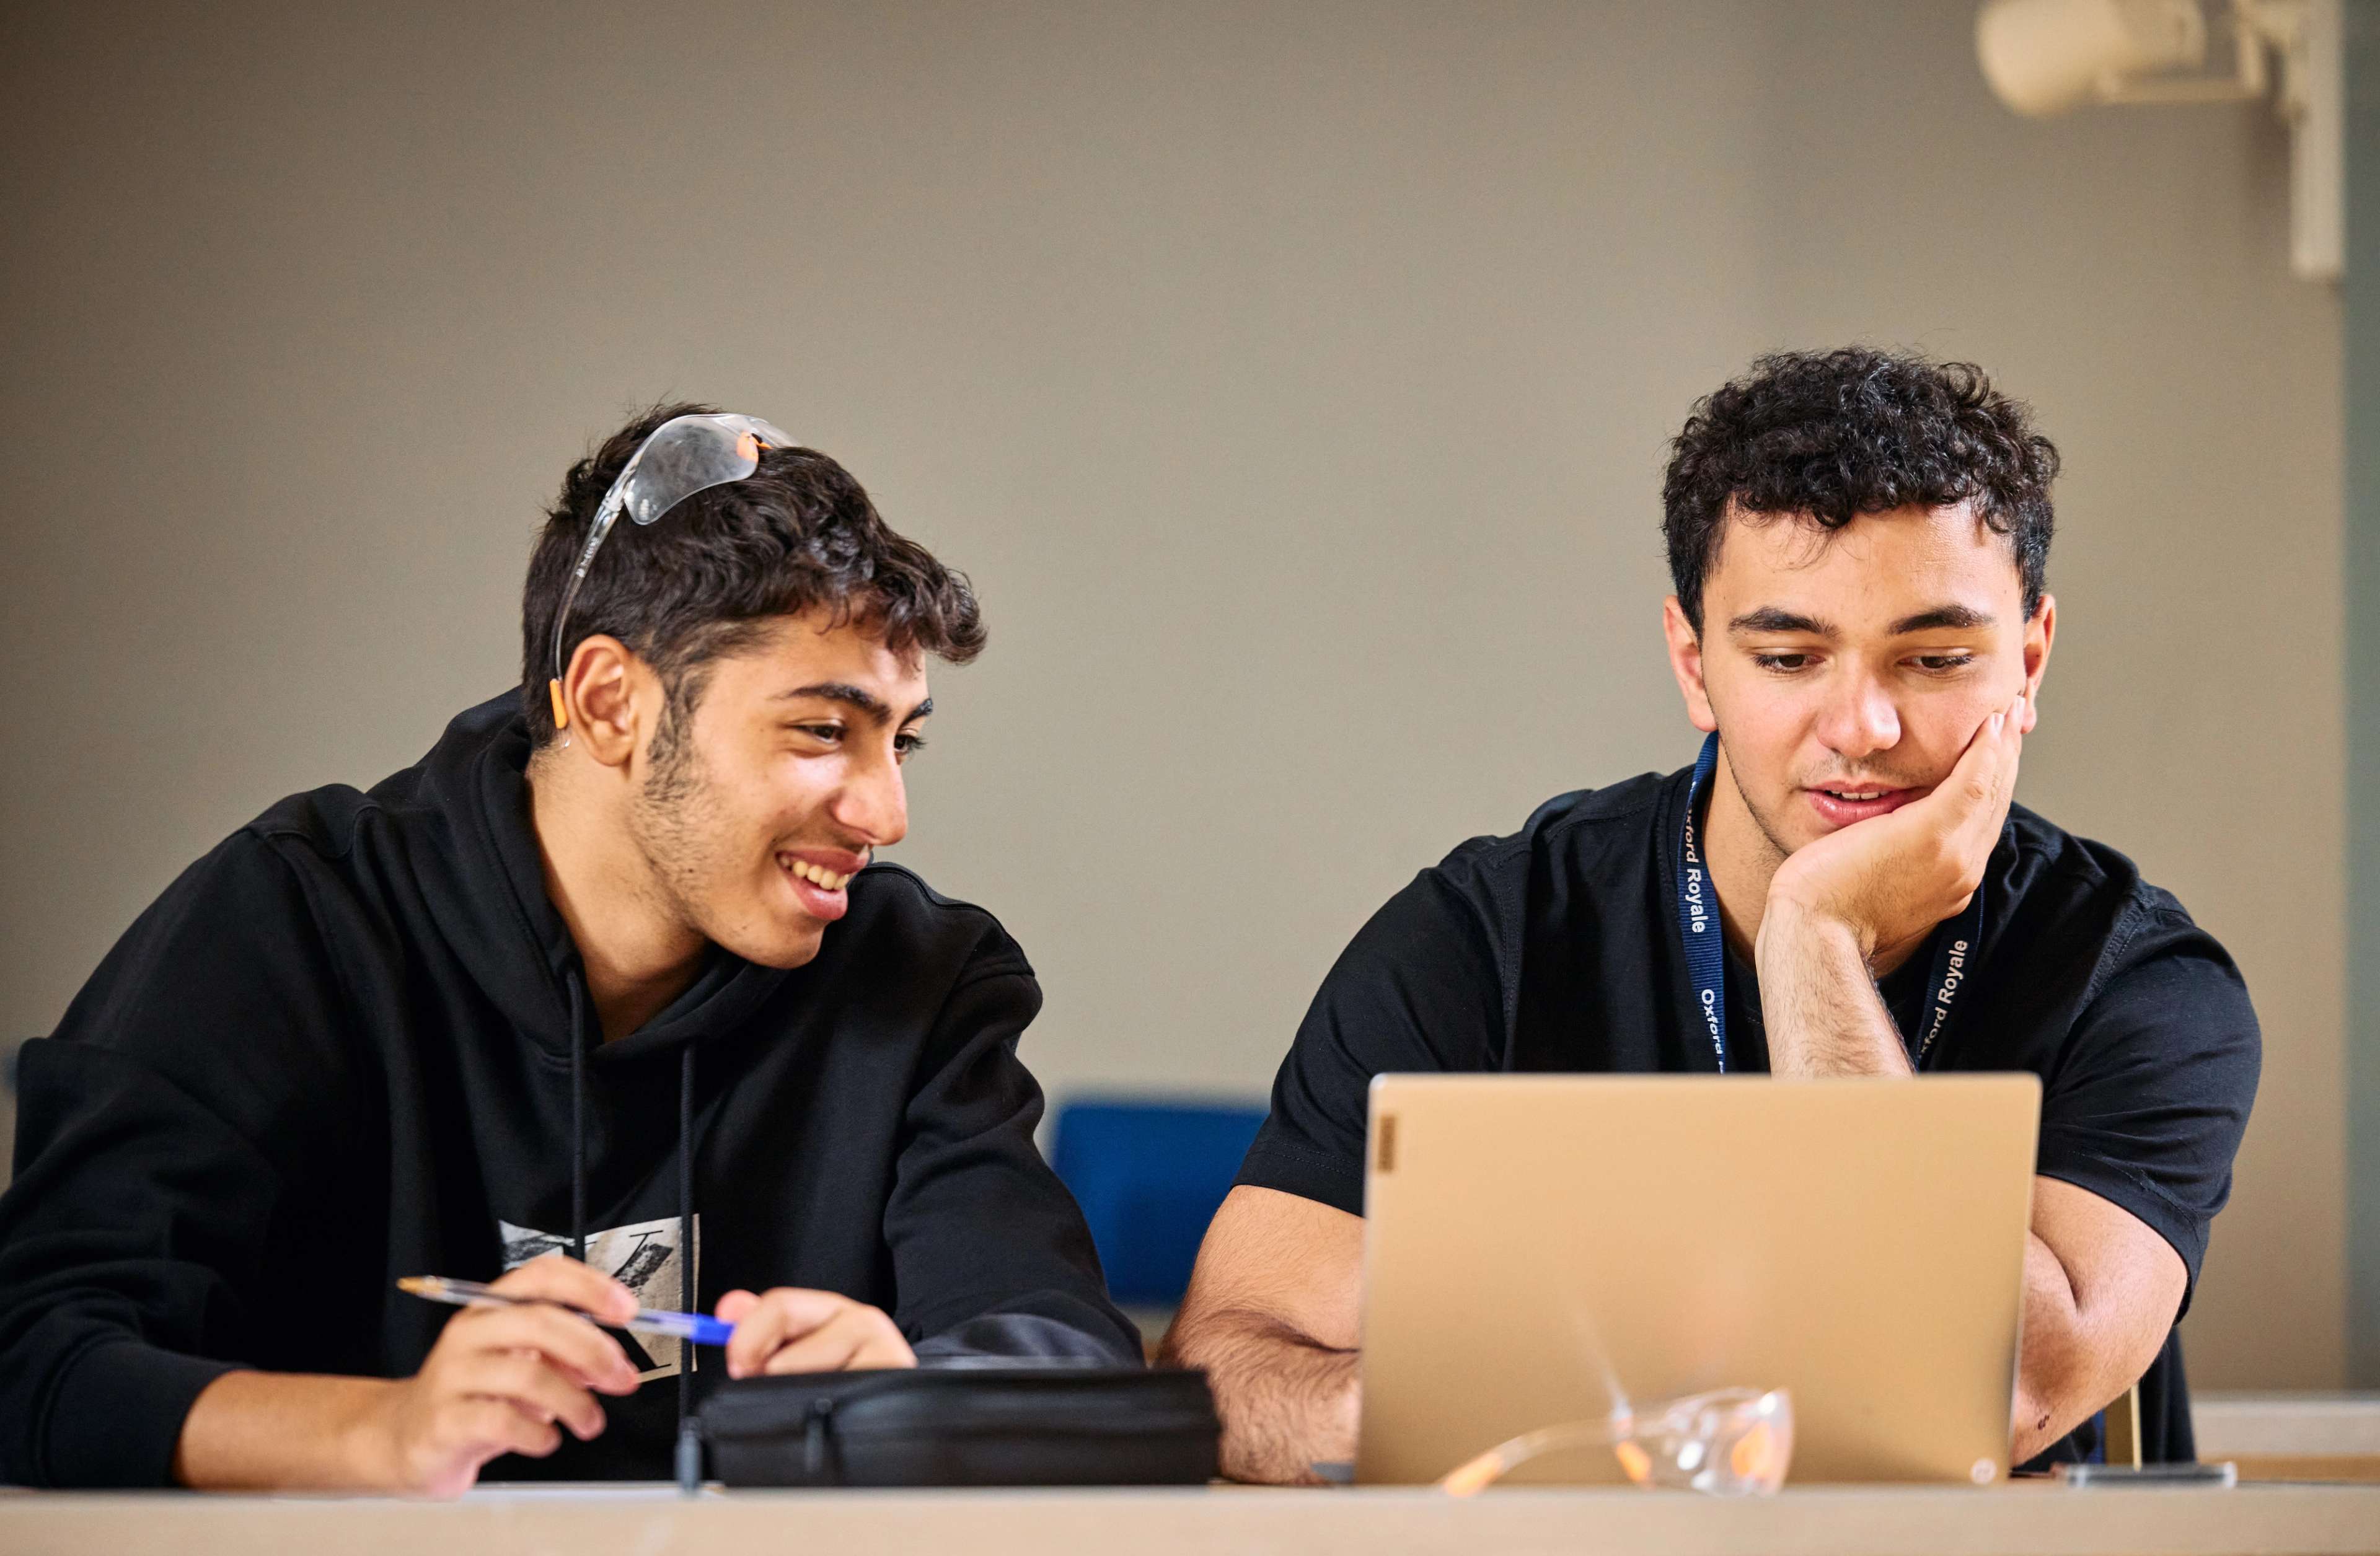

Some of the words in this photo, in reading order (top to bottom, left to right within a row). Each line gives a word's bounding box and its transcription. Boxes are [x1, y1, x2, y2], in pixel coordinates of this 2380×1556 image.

[1686, 807, 1699, 863] xford
[1685, 868, 1709, 933] Royale
[1937, 940, 1968, 1004] Royale
[1701, 989, 1724, 1055] Oxford
